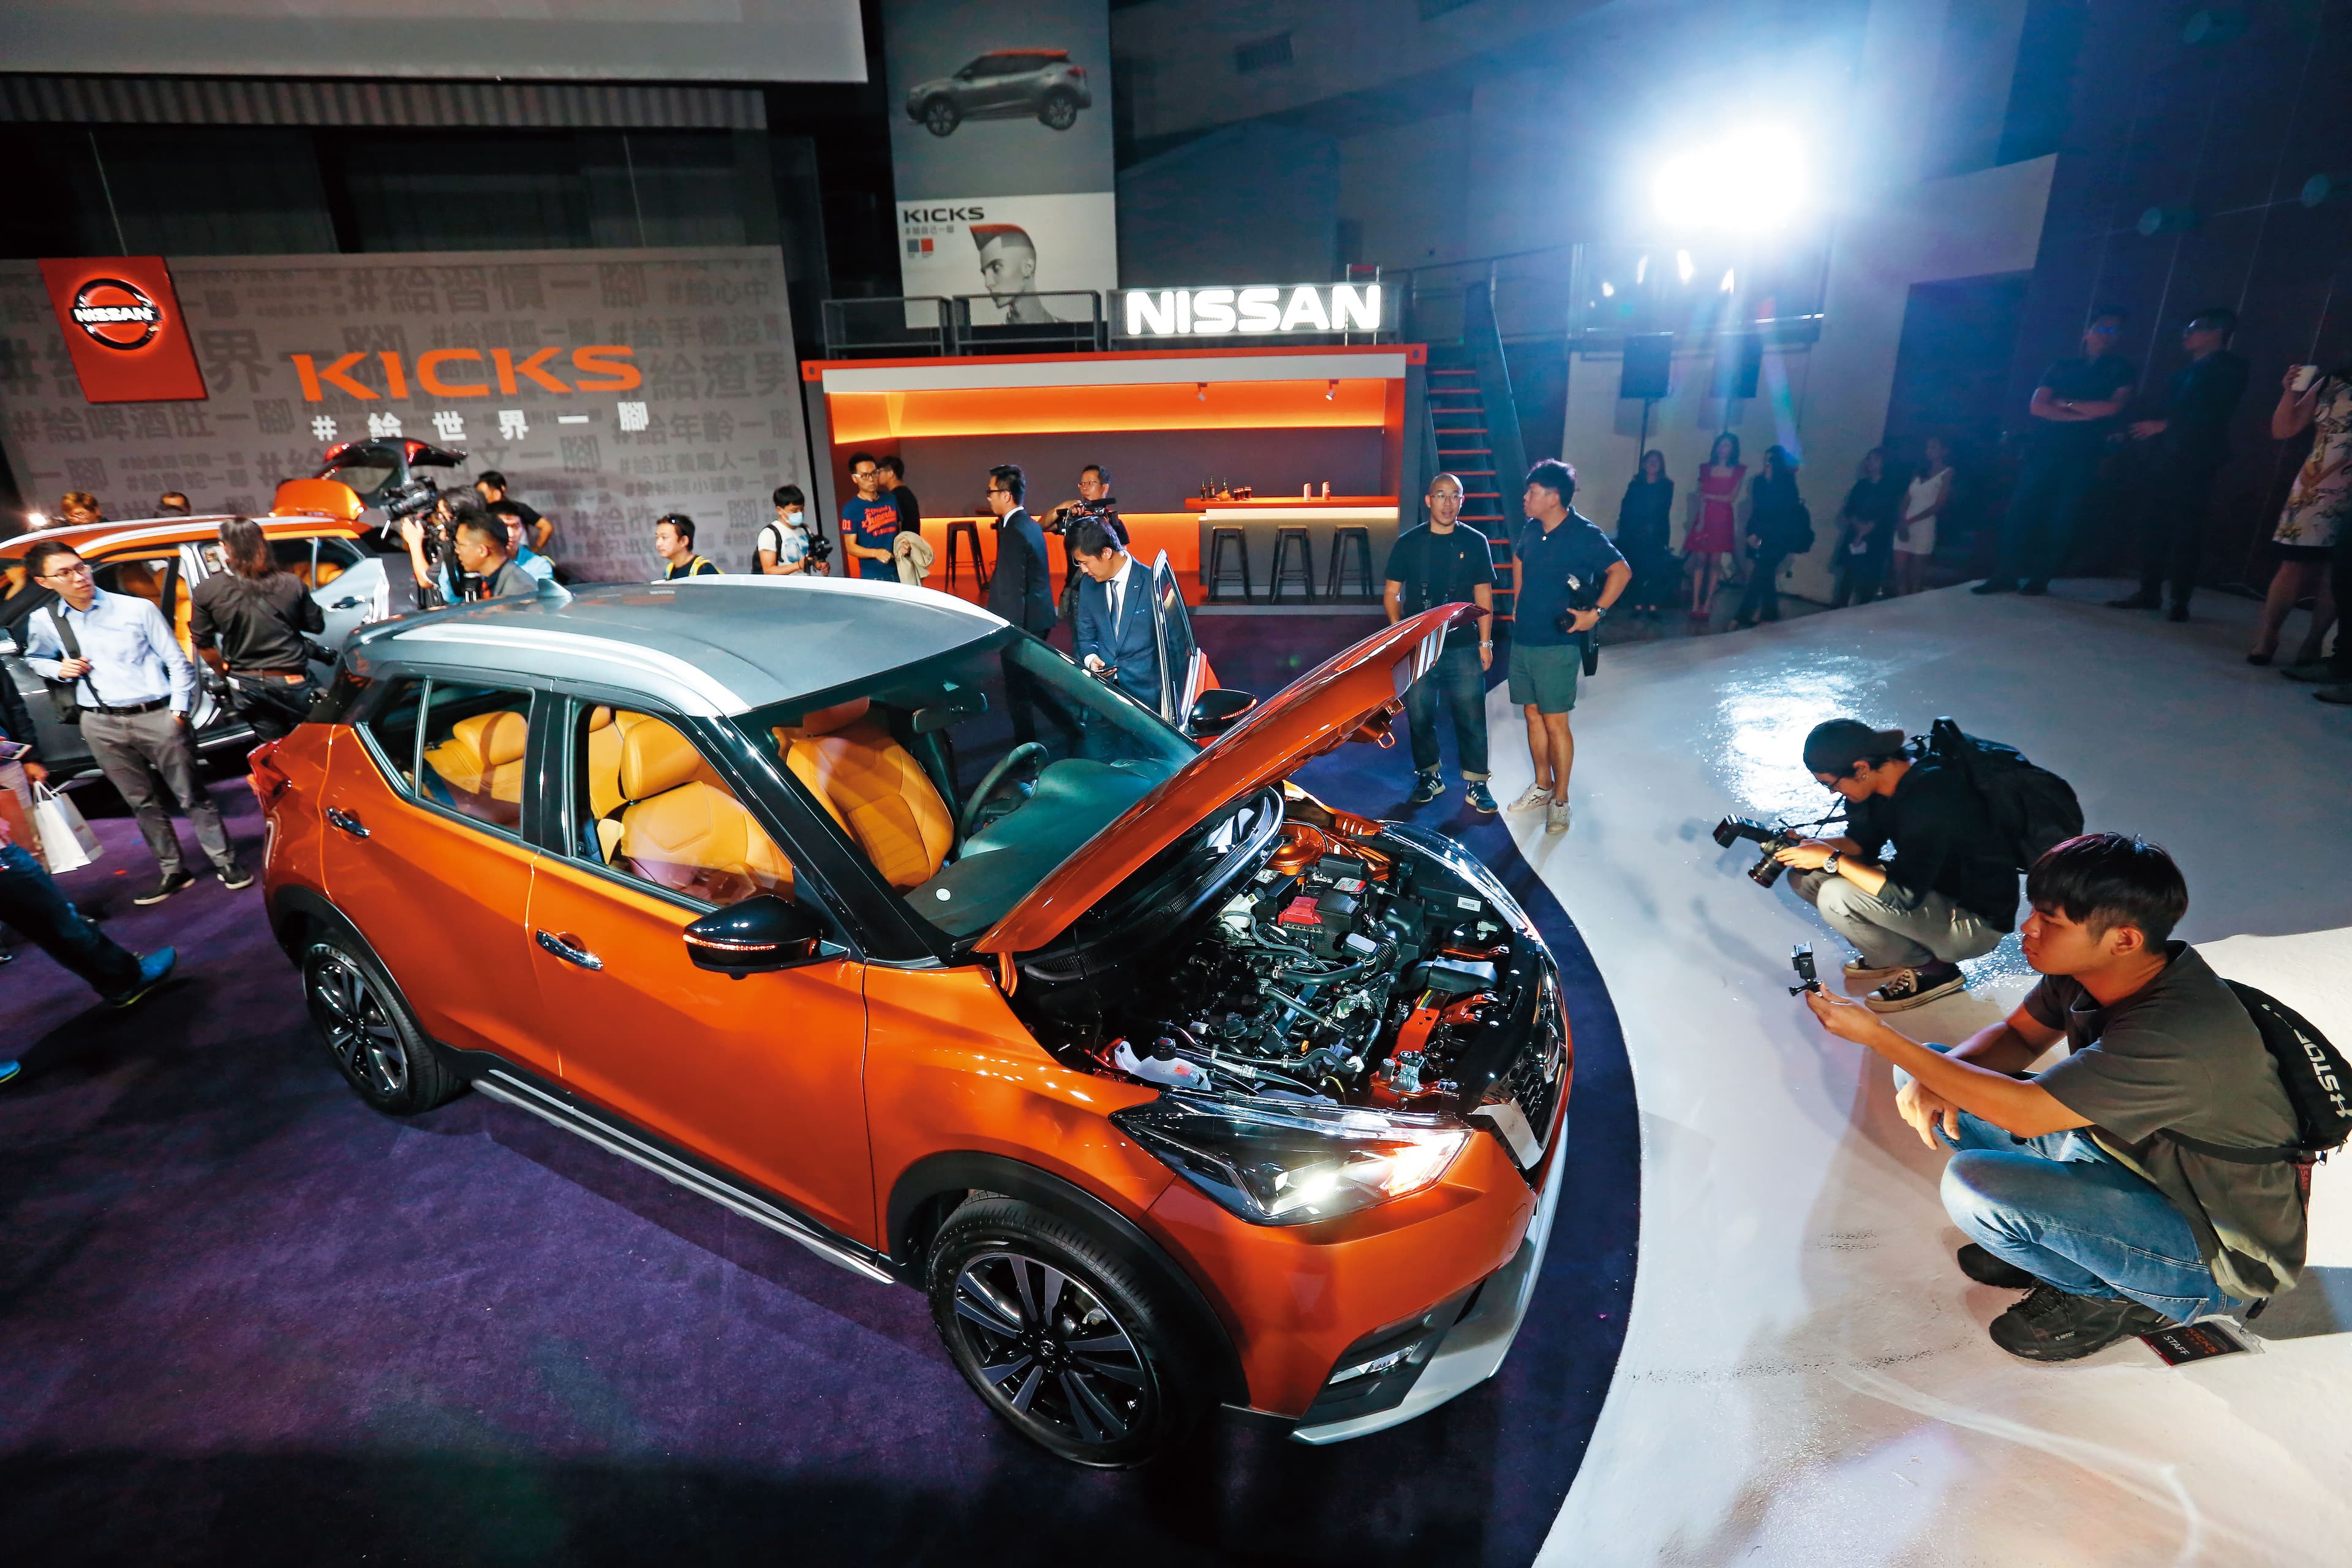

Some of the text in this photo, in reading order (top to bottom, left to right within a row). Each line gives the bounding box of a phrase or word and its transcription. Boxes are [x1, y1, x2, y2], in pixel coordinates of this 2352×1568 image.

[903, 207, 985, 223] KICKS
[74, 307, 155, 323] NISSAN
[1126, 285, 1381, 335] NISSAN
[291, 345, 642, 402] KICKS
[2163, 1335, 2190, 1355] STAFF
